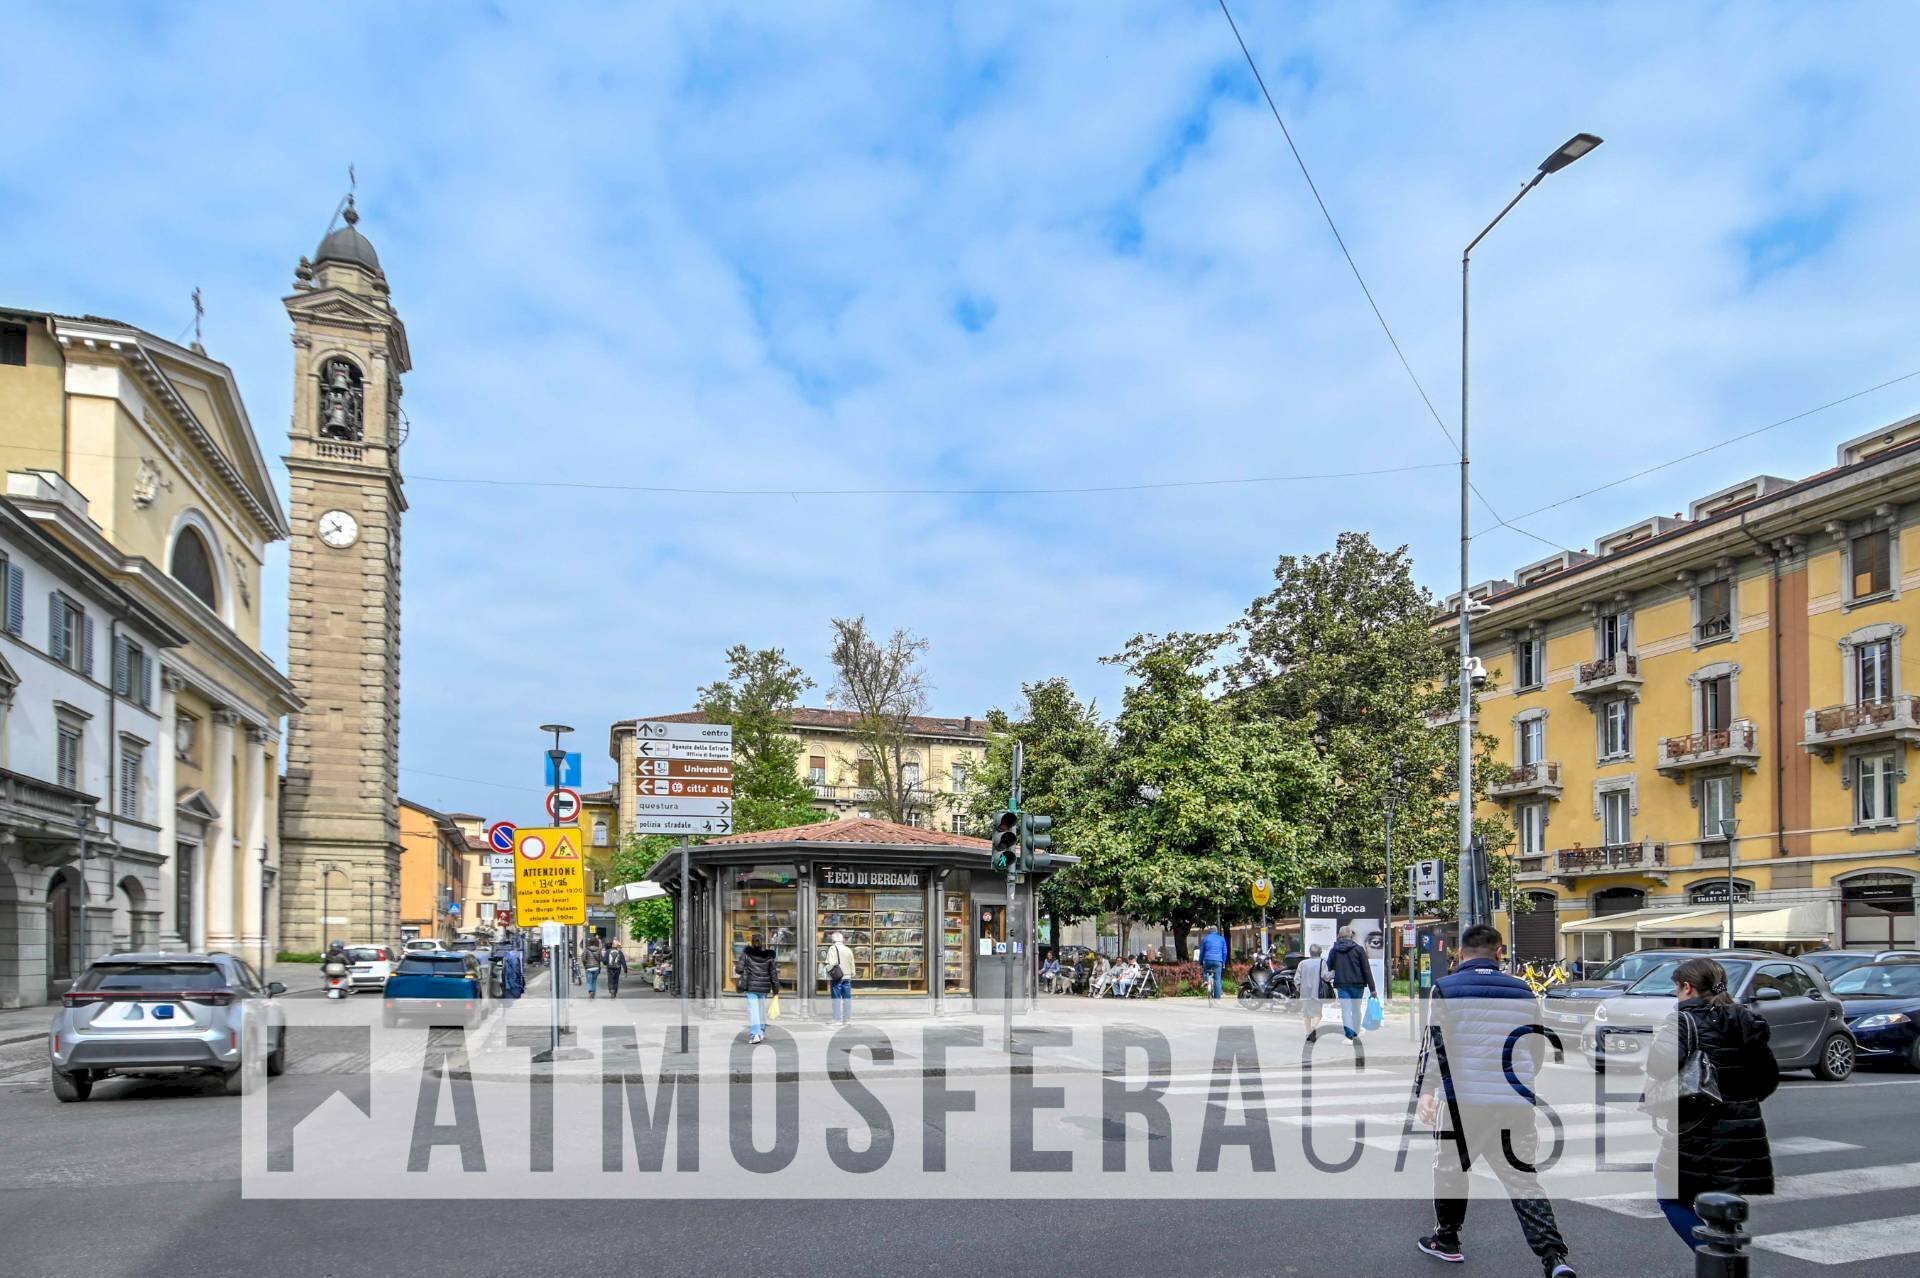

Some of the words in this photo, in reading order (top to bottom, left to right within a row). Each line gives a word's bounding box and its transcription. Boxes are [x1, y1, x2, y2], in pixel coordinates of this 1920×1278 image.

[702, 729, 728, 737] centro
[684, 764, 728, 773] Università
[712, 785, 728, 793] alta
[640, 802, 679, 810] questura
[640, 821, 661, 829] polizia
[523, 867, 576, 877] ATTENZIONE
[827, 871, 855, 885] L'ECO
[857, 872, 868, 885] DI
[870, 873, 919, 886] BERGAMO
[1310, 894, 1346, 903] Ritratto
[1310, 904, 1319, 912] di
[1321, 904, 1366, 914] un'Epoca
